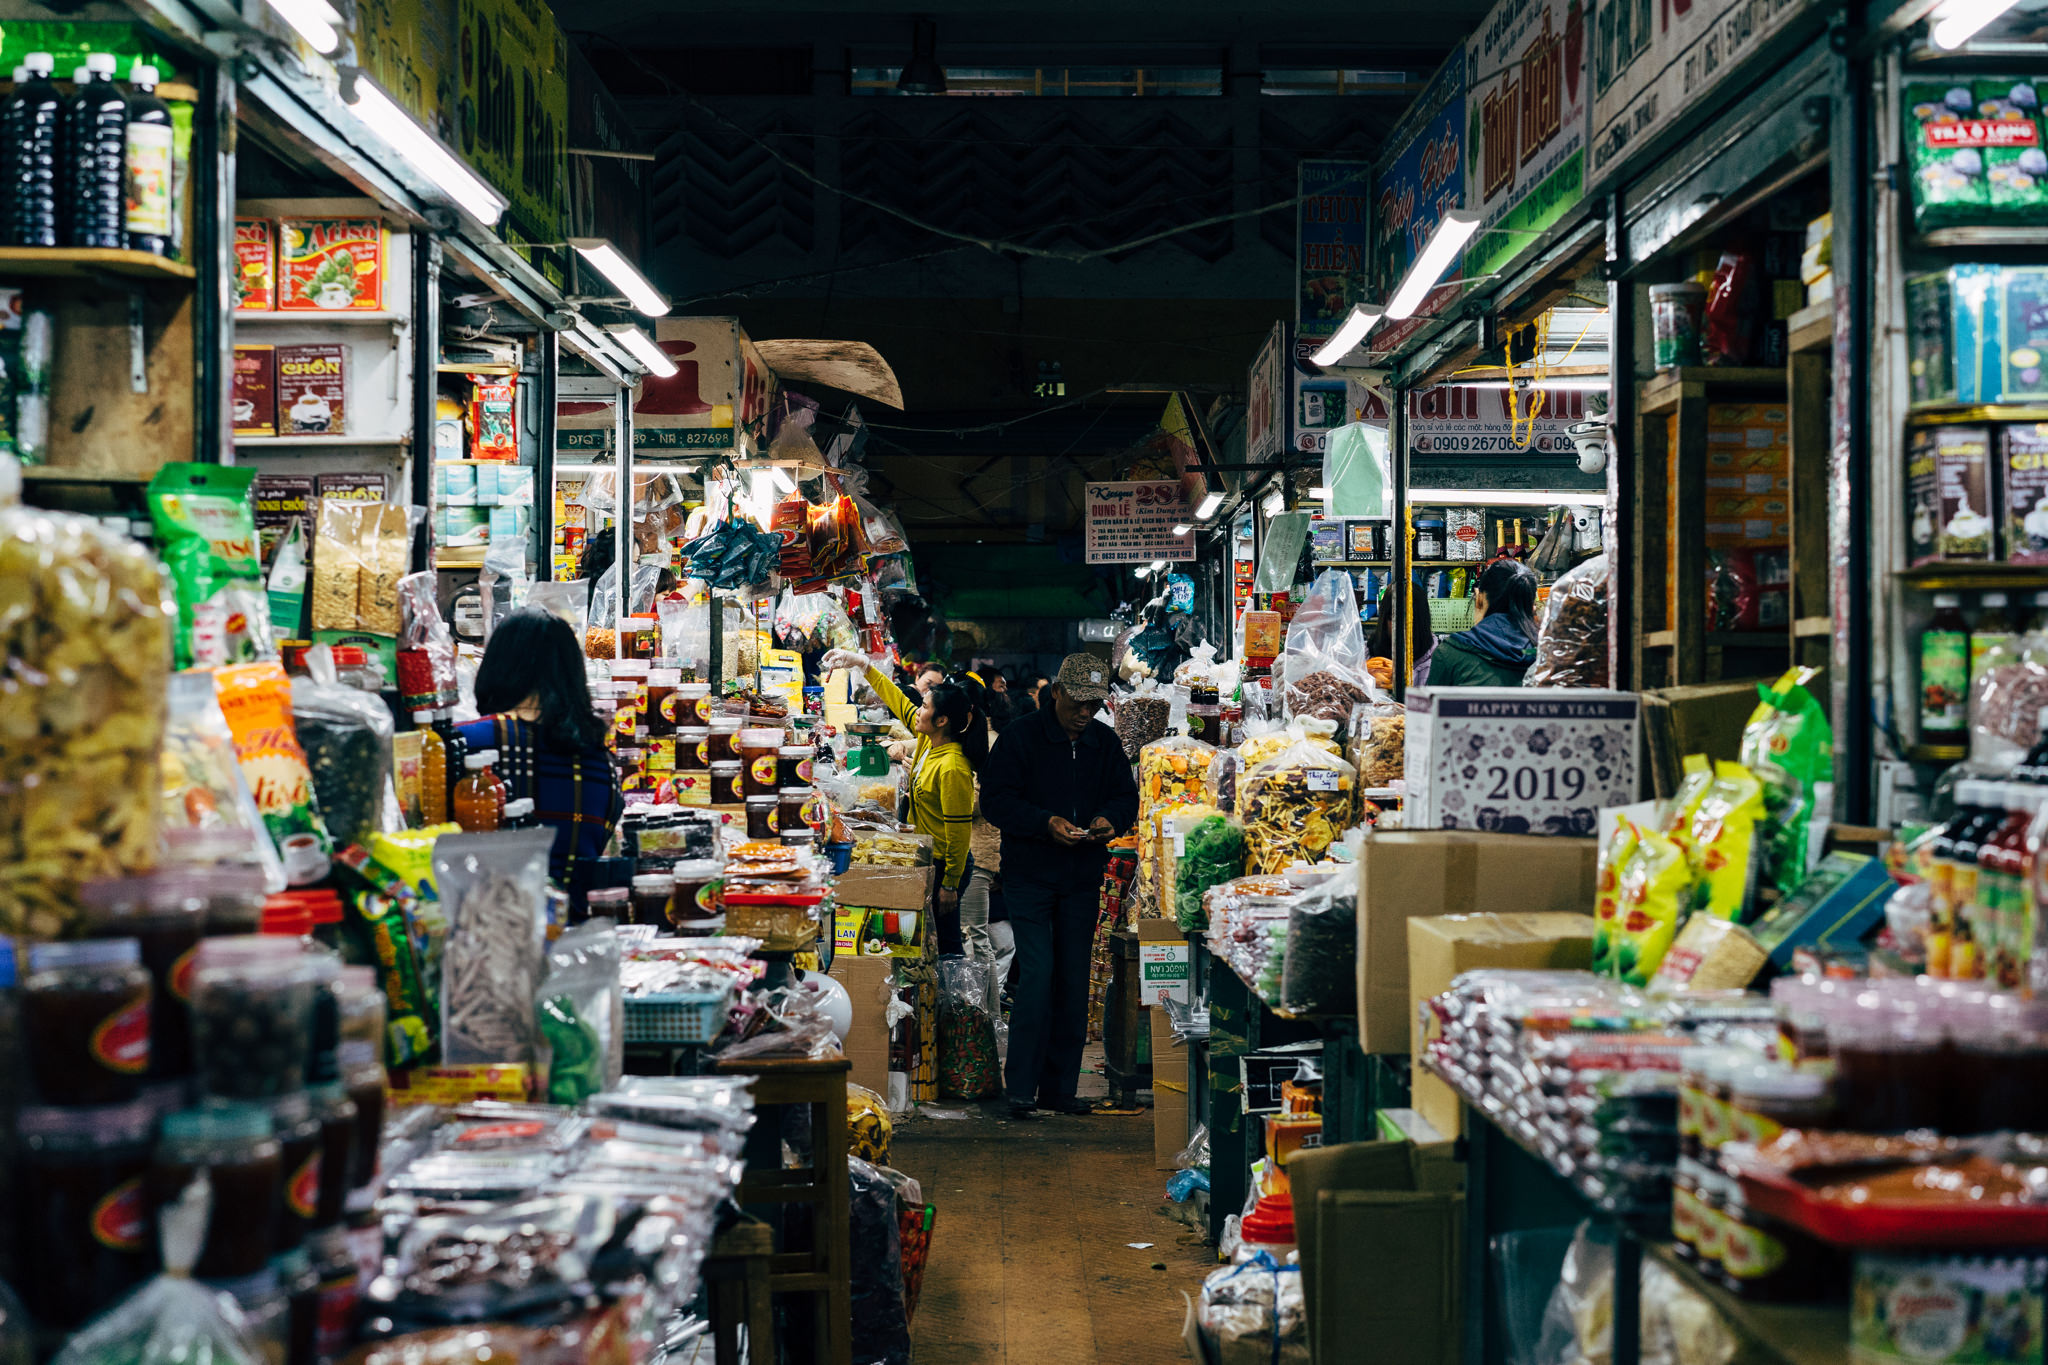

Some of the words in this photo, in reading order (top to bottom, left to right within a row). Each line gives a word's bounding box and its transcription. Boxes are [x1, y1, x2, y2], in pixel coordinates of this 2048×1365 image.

[1304, 228, 1362, 270] HIỀN
[1467, 703, 1520, 715] HAPPY
[1526, 703, 1560, 715] NEW
[1567, 703, 1608, 715] YEAR
[1487, 766, 1586, 801] 2019
[837, 929, 856, 938] LAN
